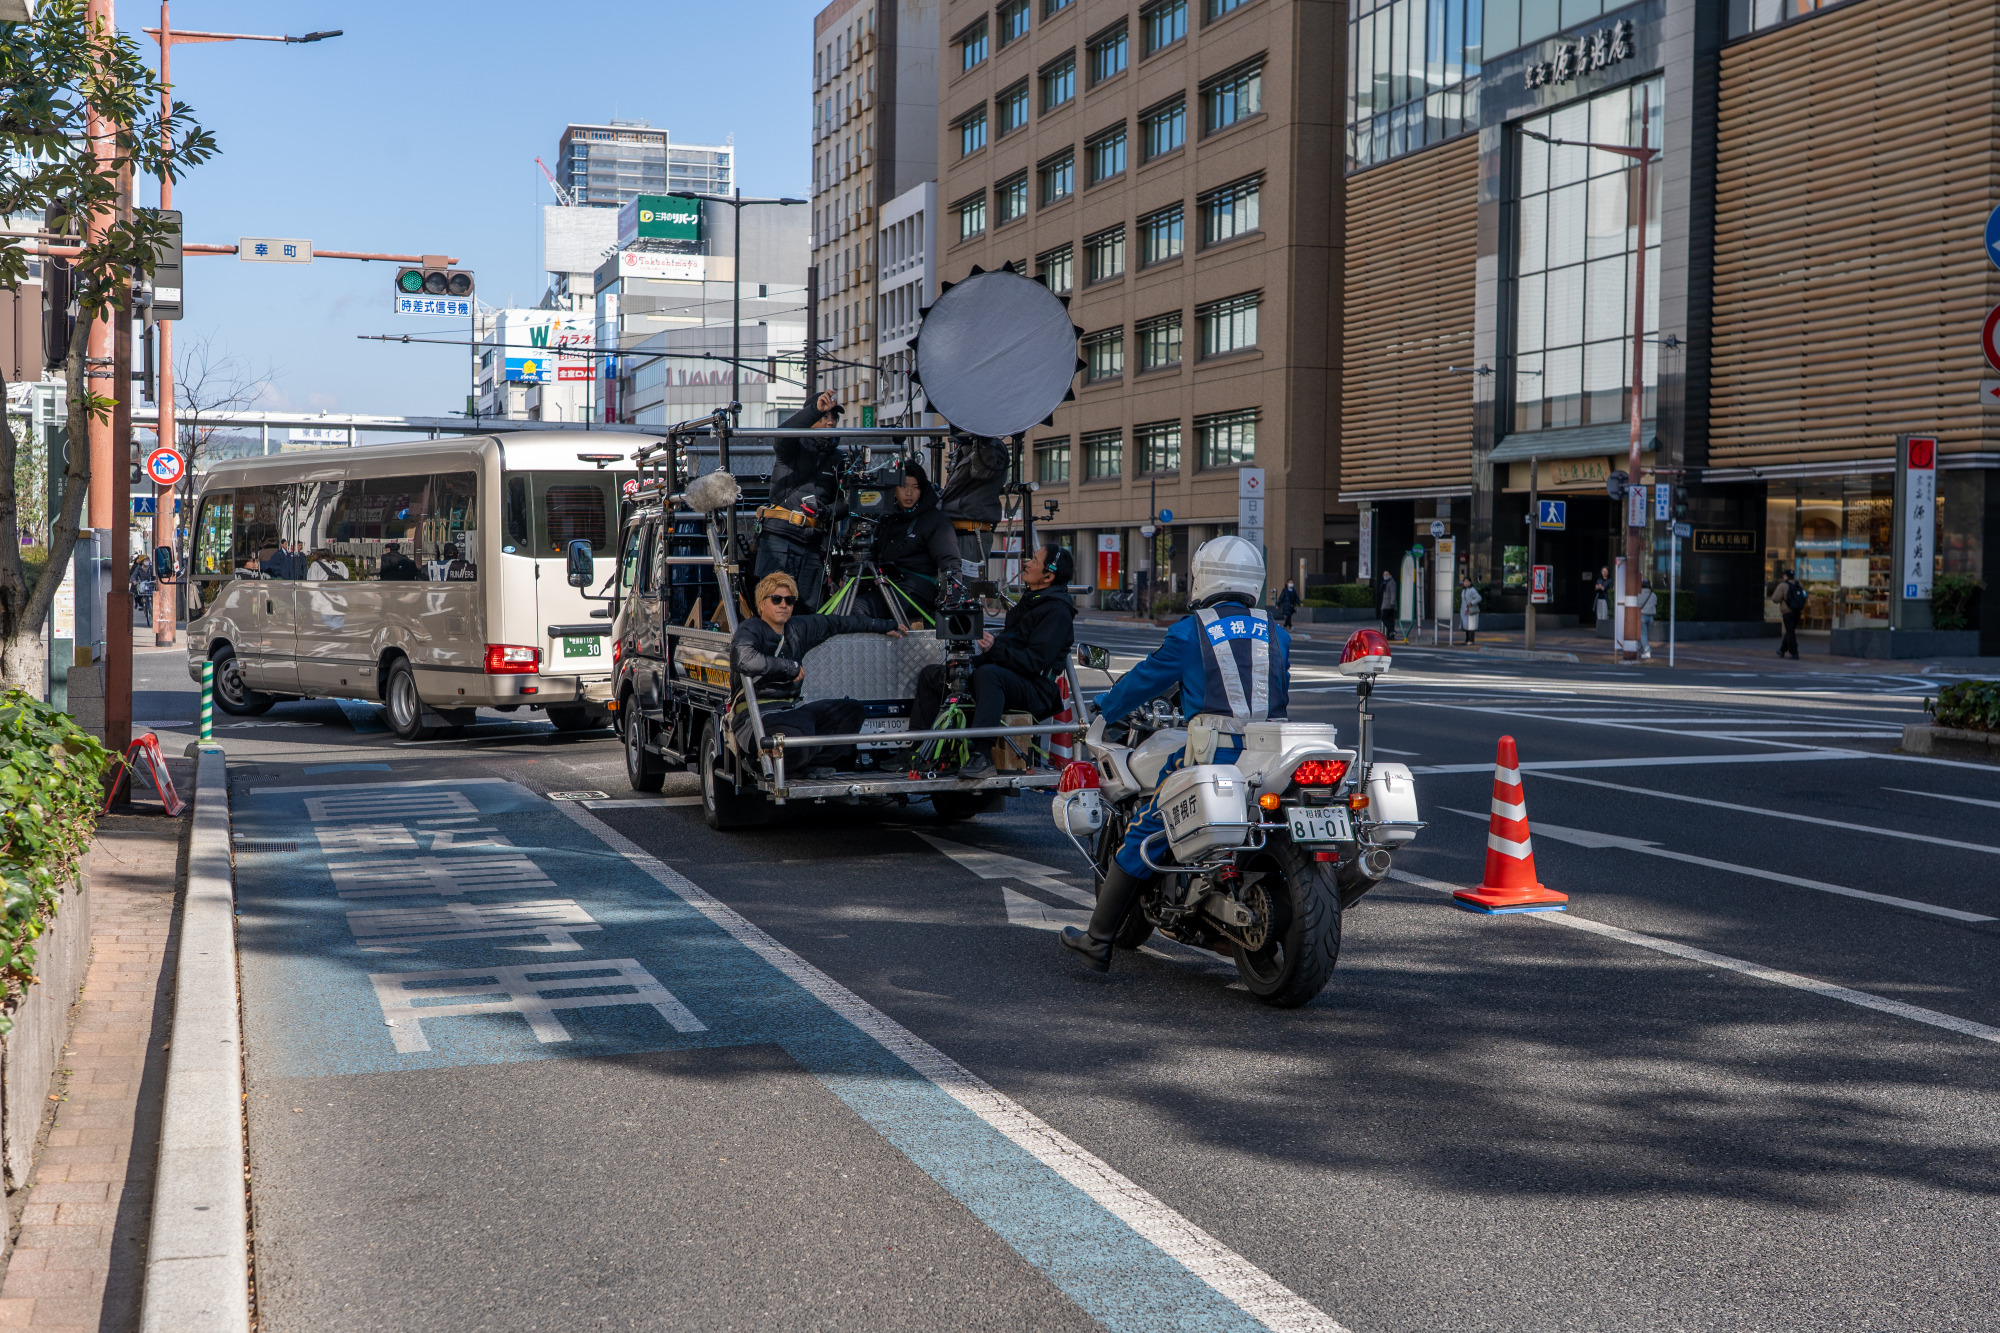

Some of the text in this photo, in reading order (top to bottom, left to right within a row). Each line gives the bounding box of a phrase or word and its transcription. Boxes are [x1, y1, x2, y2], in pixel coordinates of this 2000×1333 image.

[655, 212, 699, 225] 三井のリパーク
[254, 243, 297, 258] 幸町
[639, 256, 698, 269] Takashimaya
[401, 299, 469, 316] 時差式信号機
[558, 335, 595, 346] カラオ
[1207, 620, 1267, 640] 警視庁
[1172, 794, 1197, 827] 警視庁
[1293, 820, 1348, 839] 81-01
